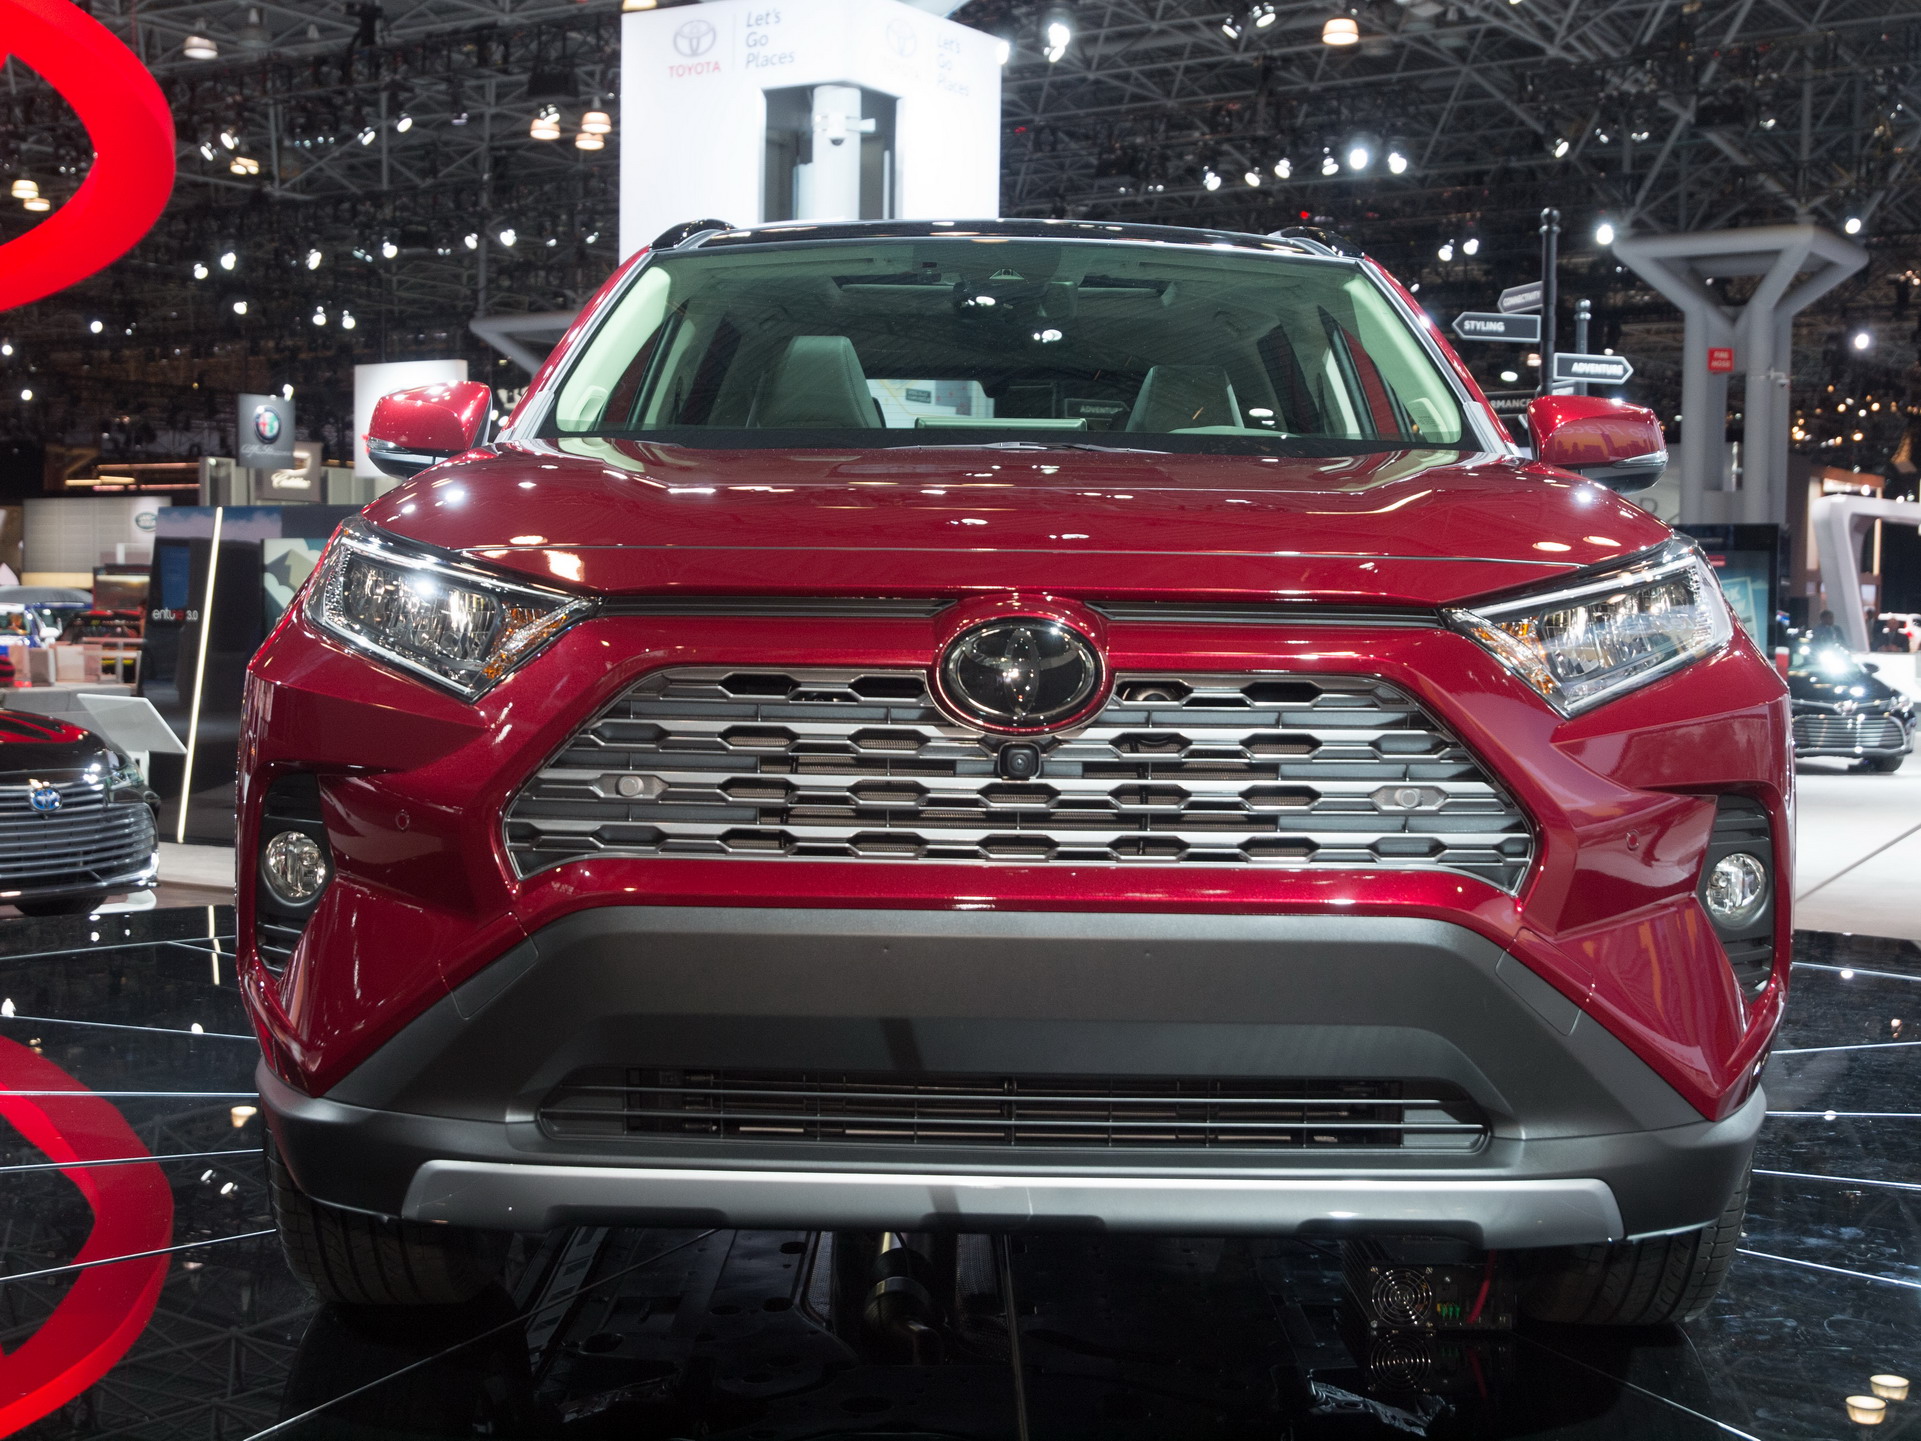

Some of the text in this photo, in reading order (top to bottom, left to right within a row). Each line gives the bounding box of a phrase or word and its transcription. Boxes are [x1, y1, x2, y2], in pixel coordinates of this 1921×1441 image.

[746, 9, 782, 28] Let's
[745, 31, 769, 48] Go
[745, 51, 796, 70] Places
[668, 61, 721, 78] TOYOTA
[1463, 320, 1506, 333] STYLING
[1571, 361, 1624, 377] ADVENTURE
[186, 609, 199, 621] 3.0
